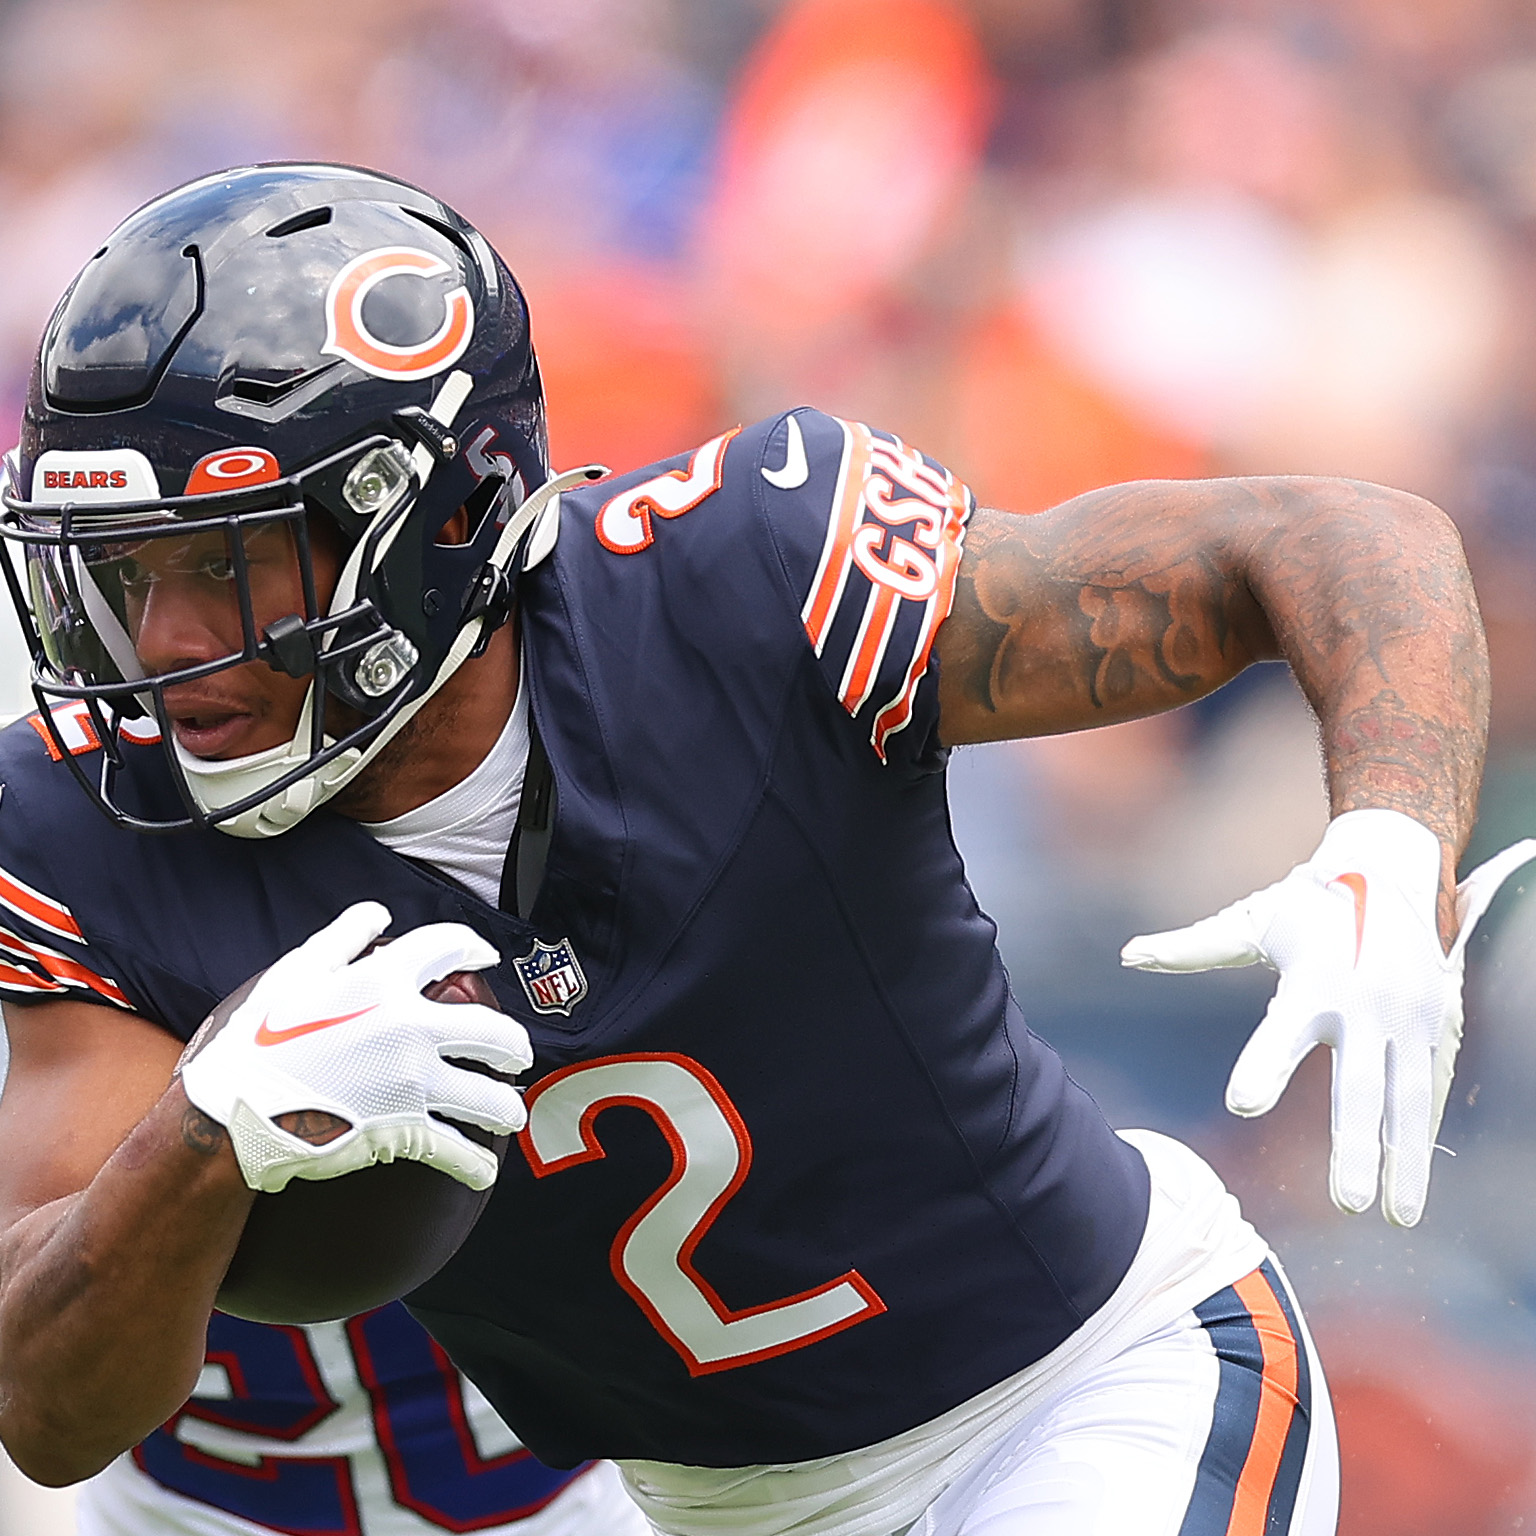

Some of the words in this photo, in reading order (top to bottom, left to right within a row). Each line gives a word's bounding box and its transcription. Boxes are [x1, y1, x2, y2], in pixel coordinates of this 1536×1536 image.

[321, 246, 474, 380] C
[43, 470, 127, 489] BEARS
[595, 423, 742, 556] 2
[851, 434, 954, 602] GSH
[531, 970, 578, 1005] NFL
[516, 1052, 889, 1377] 2
